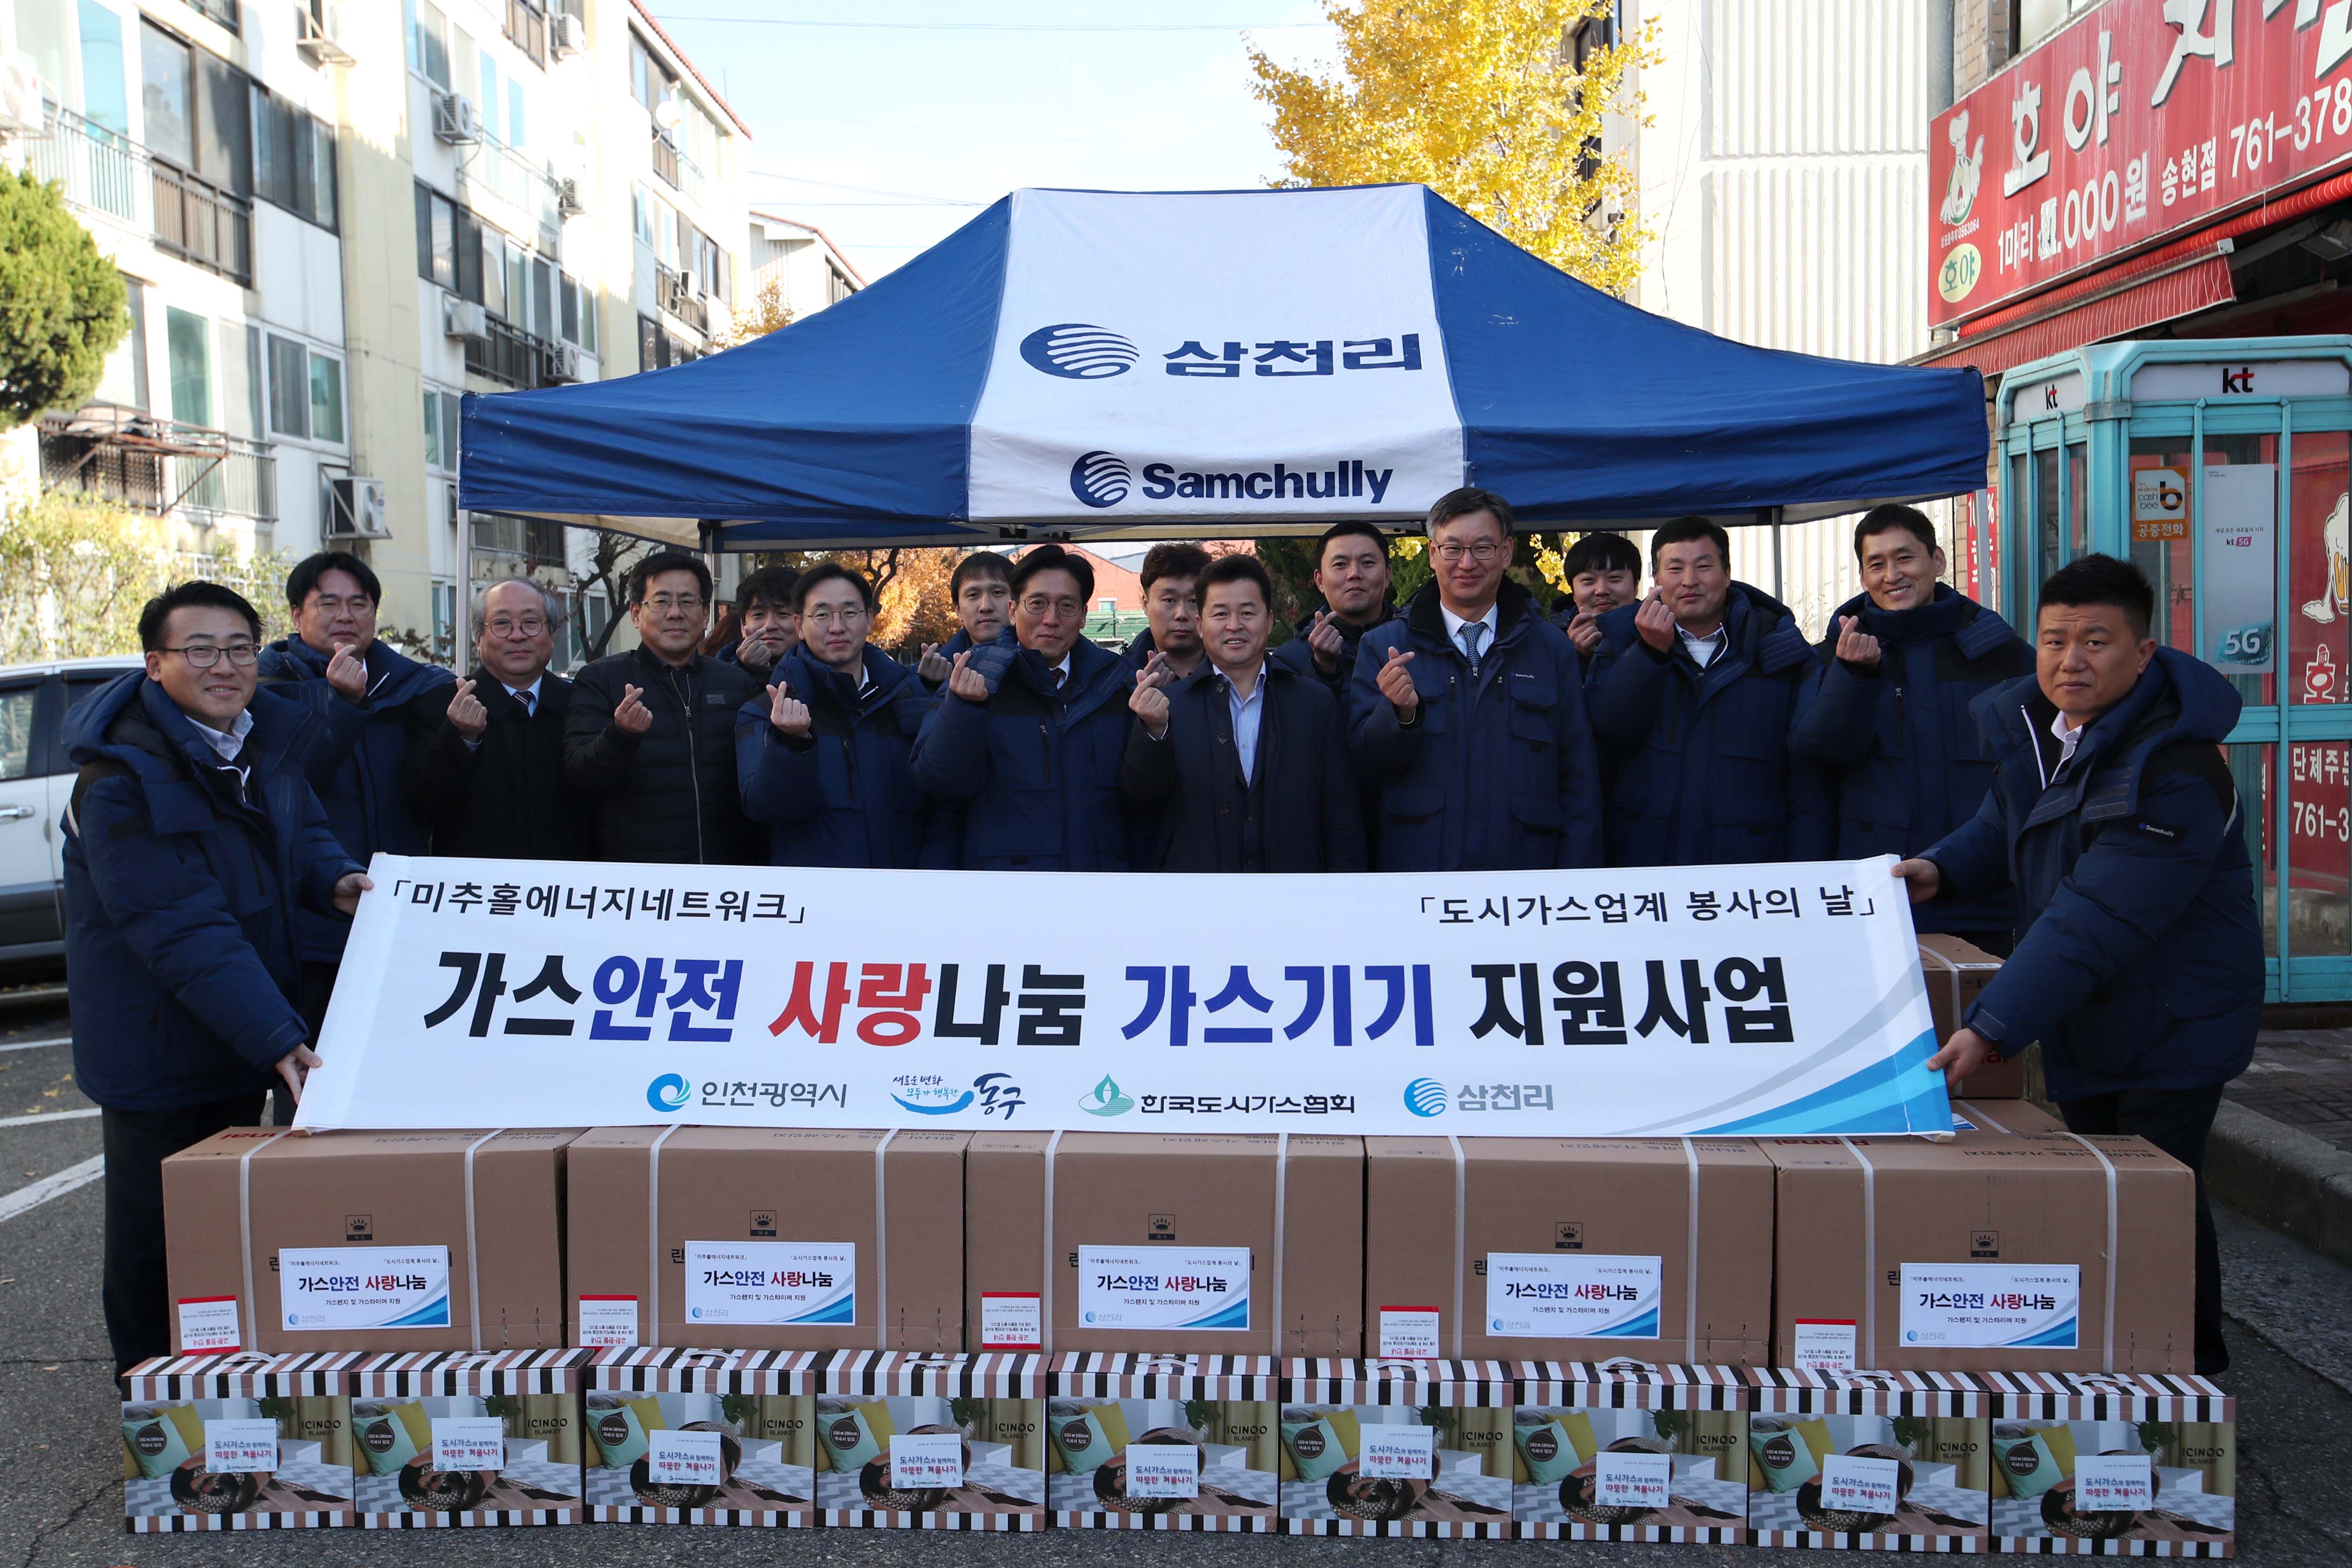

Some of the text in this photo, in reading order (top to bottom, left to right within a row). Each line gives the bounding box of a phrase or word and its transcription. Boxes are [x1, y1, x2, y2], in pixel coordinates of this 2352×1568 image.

[2161, 136, 2217, 207] 송현점
[1944, 250, 1976, 293] 호야
[1163, 333, 1423, 378] 삼천리
[2221, 368, 2255, 394] kt
[2046, 384, 2059, 410] kt
[1142, 459, 1394, 505] Samchully
[2137, 492, 2159, 502] cash
[2139, 501, 2159, 509] bee
[2137, 522, 2185, 538] 공중전화
[2226, 538, 2235, 546] kt
[2224, 628, 2262, 656] 5G
[1685, 887, 1801, 921] 봉사의
[424, 951, 1795, 1047] 가스안전 사랑나눔 가스기기 지원사업
[702, 1081, 848, 1109] 인천광역시
[932, 1087, 959, 1100] 행복한
[973, 1072, 1026, 1121] 동구
[1456, 1084, 1555, 1112] 삼천리
[1140, 1094, 1356, 1115] 한국도시가스협회
[1774, 1139, 1870, 1147] Rnnai
[299, 1275, 426, 1292] 가스안전 사랑나눔
[704, 1271, 832, 1287] 가스안전 사랑나눔
[1097, 1276, 1227, 1292] 가스안전 사랑나눔
[1506, 1283, 1637, 1300] 가스안전 사랑나눔
[1920, 1293, 2055, 1310] 가스안전 사랑나눔
[302, 1420, 341, 1429] ICINOO
[528, 1418, 568, 1427] ICINOO
[764, 1419, 803, 1429] ICINOO
[995, 1423, 1035, 1432] ICINOO
[1228, 1426, 1267, 1434] ICINOO
[1463, 1432, 1503, 1440] ICINOO
[1696, 1435, 1737, 1444] ICINOO
[443, 1448, 498, 1458] 따뜻한 겨울나기
[1936, 1443, 1978, 1452] ICINOO
[2183, 1448, 2224, 1457] ICINOO
[215, 1450, 272, 1459] 따뜻한 겨울나기
[659, 1461, 715, 1471] 따뜻한 겨울나기
[1369, 1456, 1426, 1465] 따뜻한 겨울나기
[900, 1466, 956, 1475] 따뜻한 겨울나기
[1136, 1475, 1192, 1484] 따뜻한 겨울나기
[1606, 1484, 1663, 1494] 따뜻한 겨울나기
[1832, 1487, 1890, 1500] 따뜻한 겨울나기
[2085, 1488, 2146, 1497] 따뜻한 겨울나기
